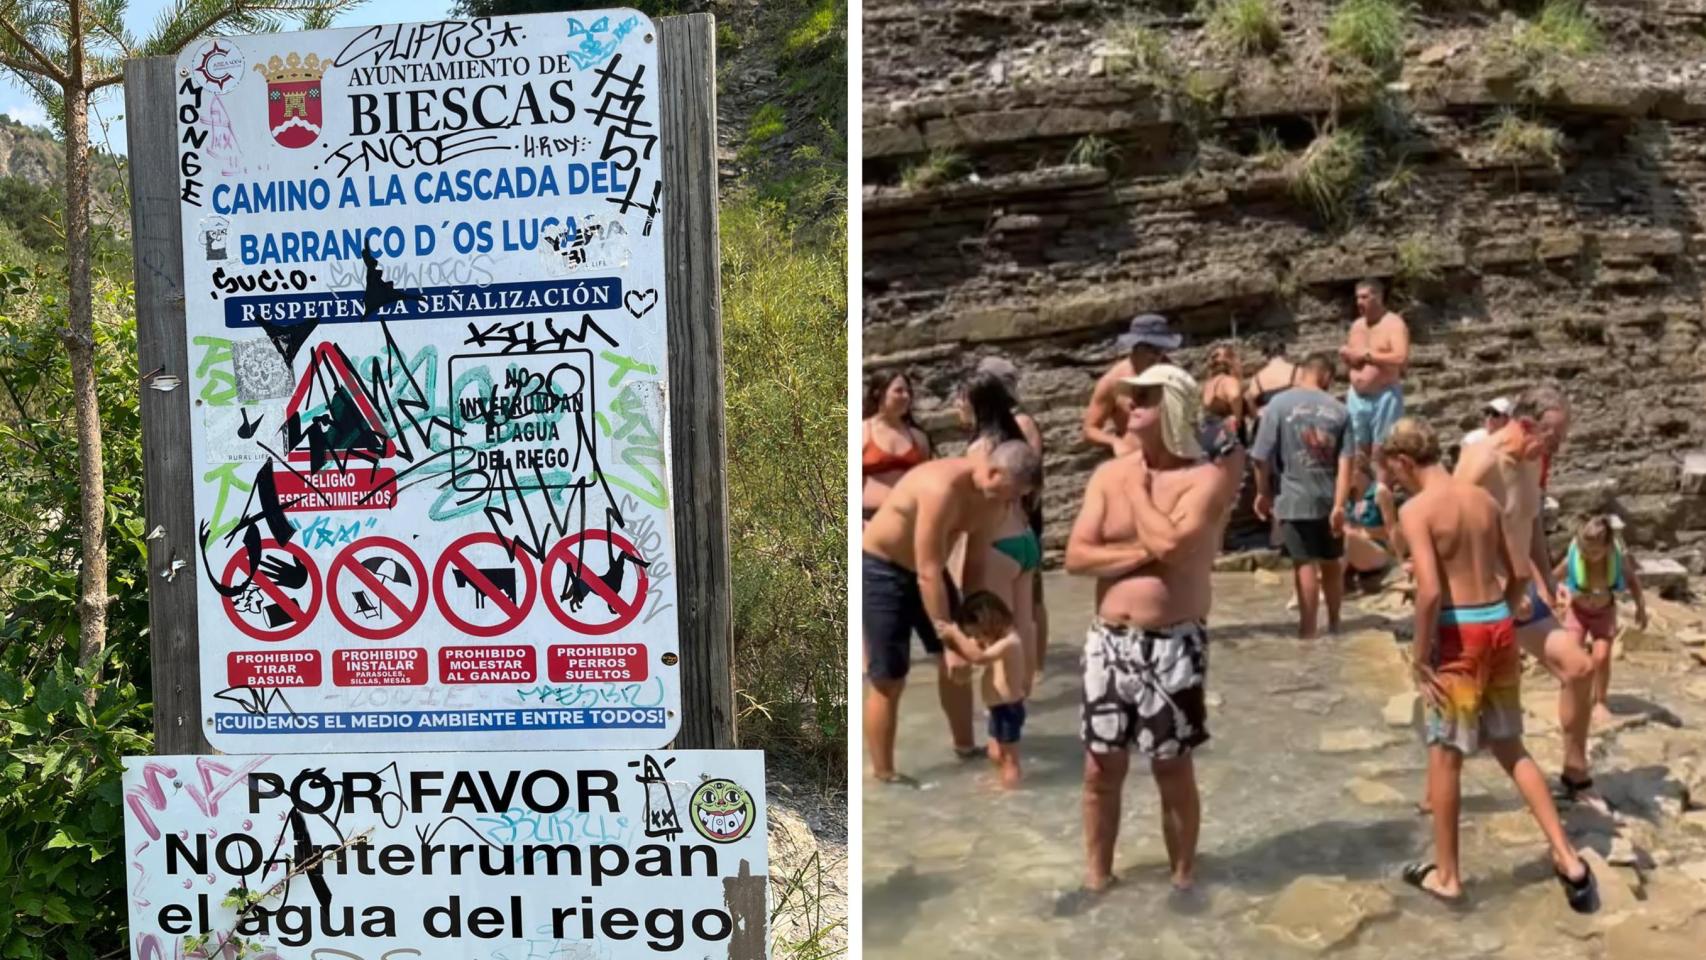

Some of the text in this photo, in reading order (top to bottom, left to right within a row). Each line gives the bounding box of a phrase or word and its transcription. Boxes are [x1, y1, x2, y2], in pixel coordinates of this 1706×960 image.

[349, 54, 571, 87] AYUNTAMIENTO DE
[348, 80, 576, 136] BIESCAS
[212, 161, 627, 215] CAMINO A LA CASCADA DEL
[240, 225, 405, 266] BARRANCO
[241, 298, 367, 322] RESPETEN
[417, 282, 610, 314] SEÑALIZACIÓN
[505, 367, 529, 389] NO
[459, 393, 583, 416] INTERRUMPAN
[512, 421, 560, 442] AGUA
[477, 448, 569, 470] DEL RIEGO
[304, 473, 356, 489] PELIGRO
[278, 490, 391, 508] ESPRENDIMIENTOS
[236, 653, 314, 663] PROHIBIDO
[342, 650, 418, 660] PROHIBIDO
[445, 649, 526, 659] PROHIBIDO
[557, 647, 637, 657] PROHIBIDO
[254, 665, 297, 674] TIRAR
[346, 661, 414, 671] INSTALAR
[450, 660, 522, 670] MOLESTAR
[569, 658, 626, 668] PERROS
[247, 675, 304, 685] BASURA
[447, 671, 531, 681] AL GANADO
[565, 669, 631, 680] SUELTOS
[217, 707, 664, 732] ¡CUIDEMOS EL MEDIO AMBIENTE ENTRE TODOS!
[248, 770, 384, 814] POR
[410, 769, 620, 813] FAVOR
[165, 833, 718, 886] NO interrumpan
[157, 893, 733, 952] el agua del riego
